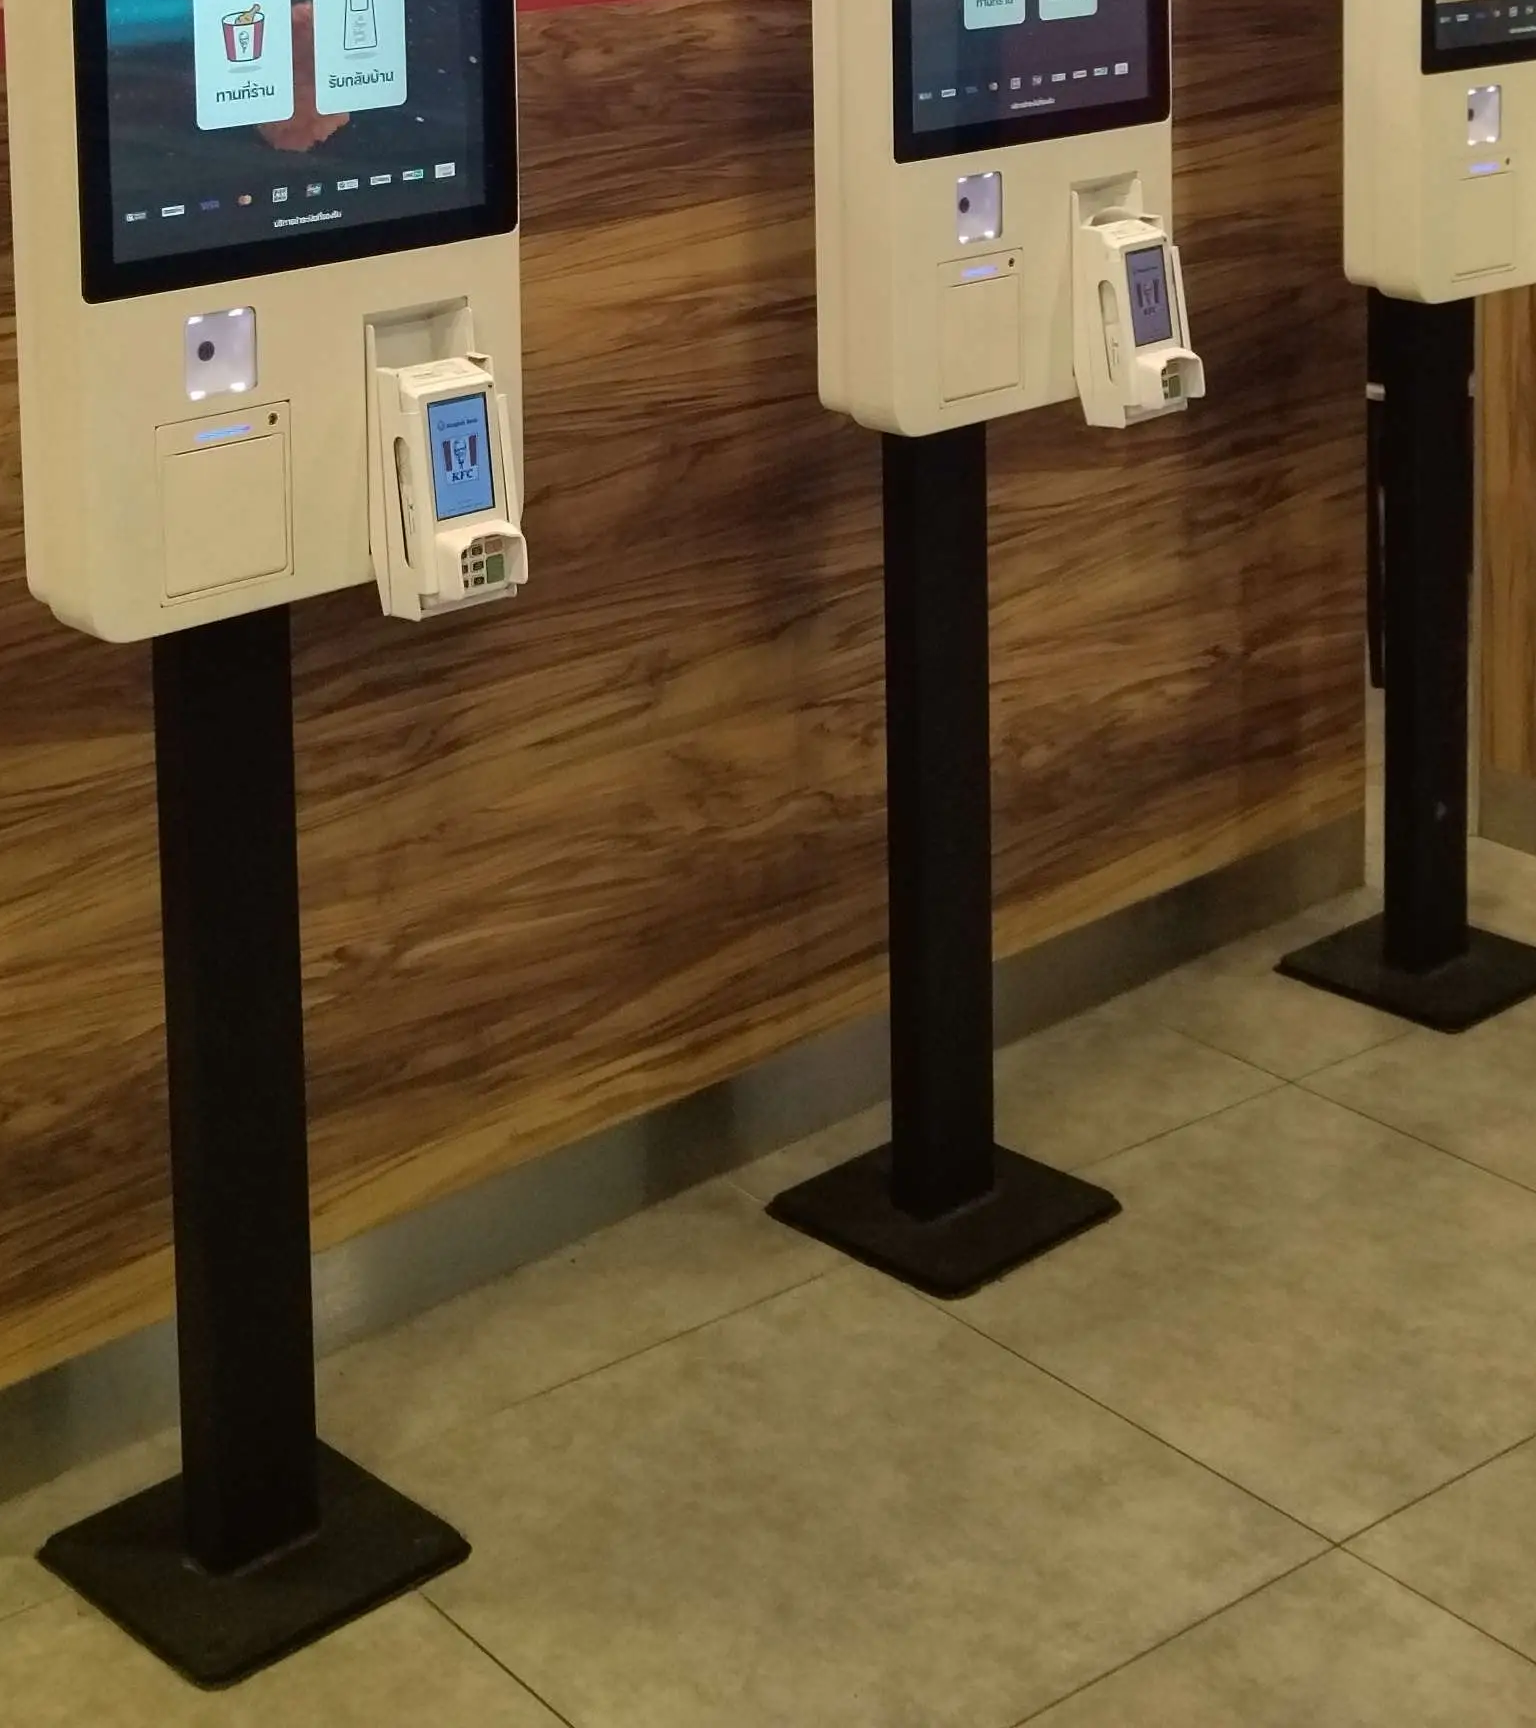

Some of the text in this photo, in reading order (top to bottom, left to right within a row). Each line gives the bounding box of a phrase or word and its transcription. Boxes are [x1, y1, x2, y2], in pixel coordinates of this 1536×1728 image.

[328, 70, 395, 89] รับกลับบ้าน
[216, 80, 275, 103] ทานที่ร้าน
